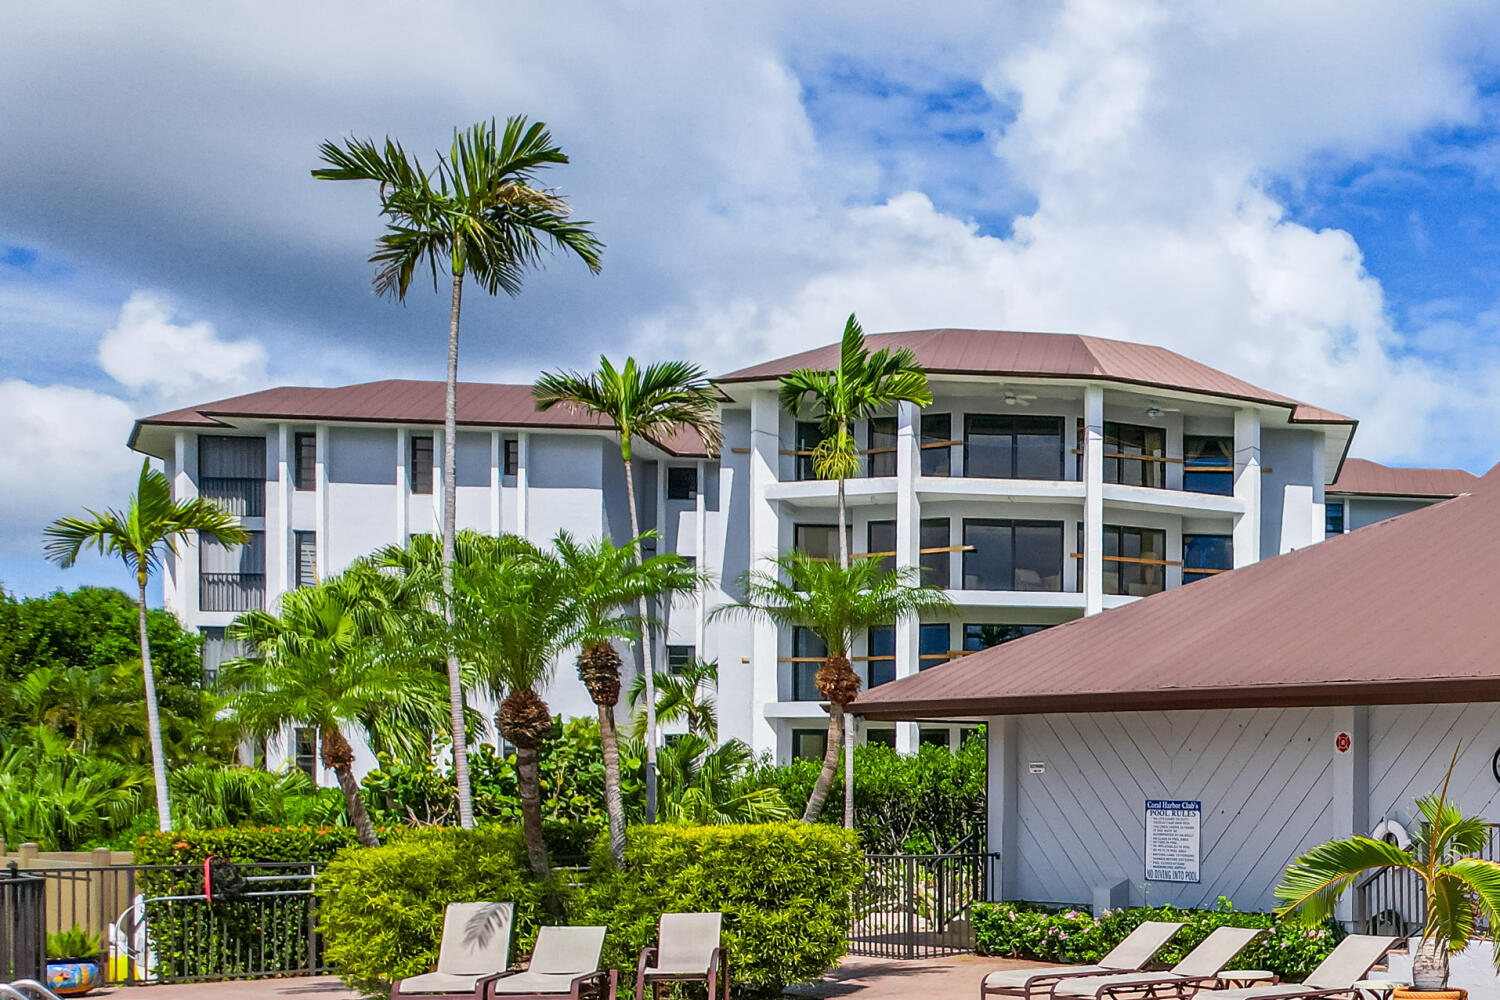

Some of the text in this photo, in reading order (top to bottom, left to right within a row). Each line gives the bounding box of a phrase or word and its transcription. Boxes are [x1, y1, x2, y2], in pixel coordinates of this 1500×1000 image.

[1147, 801, 1161, 809] Coral
[1162, 801, 1181, 809] Harbor
[1173, 870, 1185, 880] INTO
